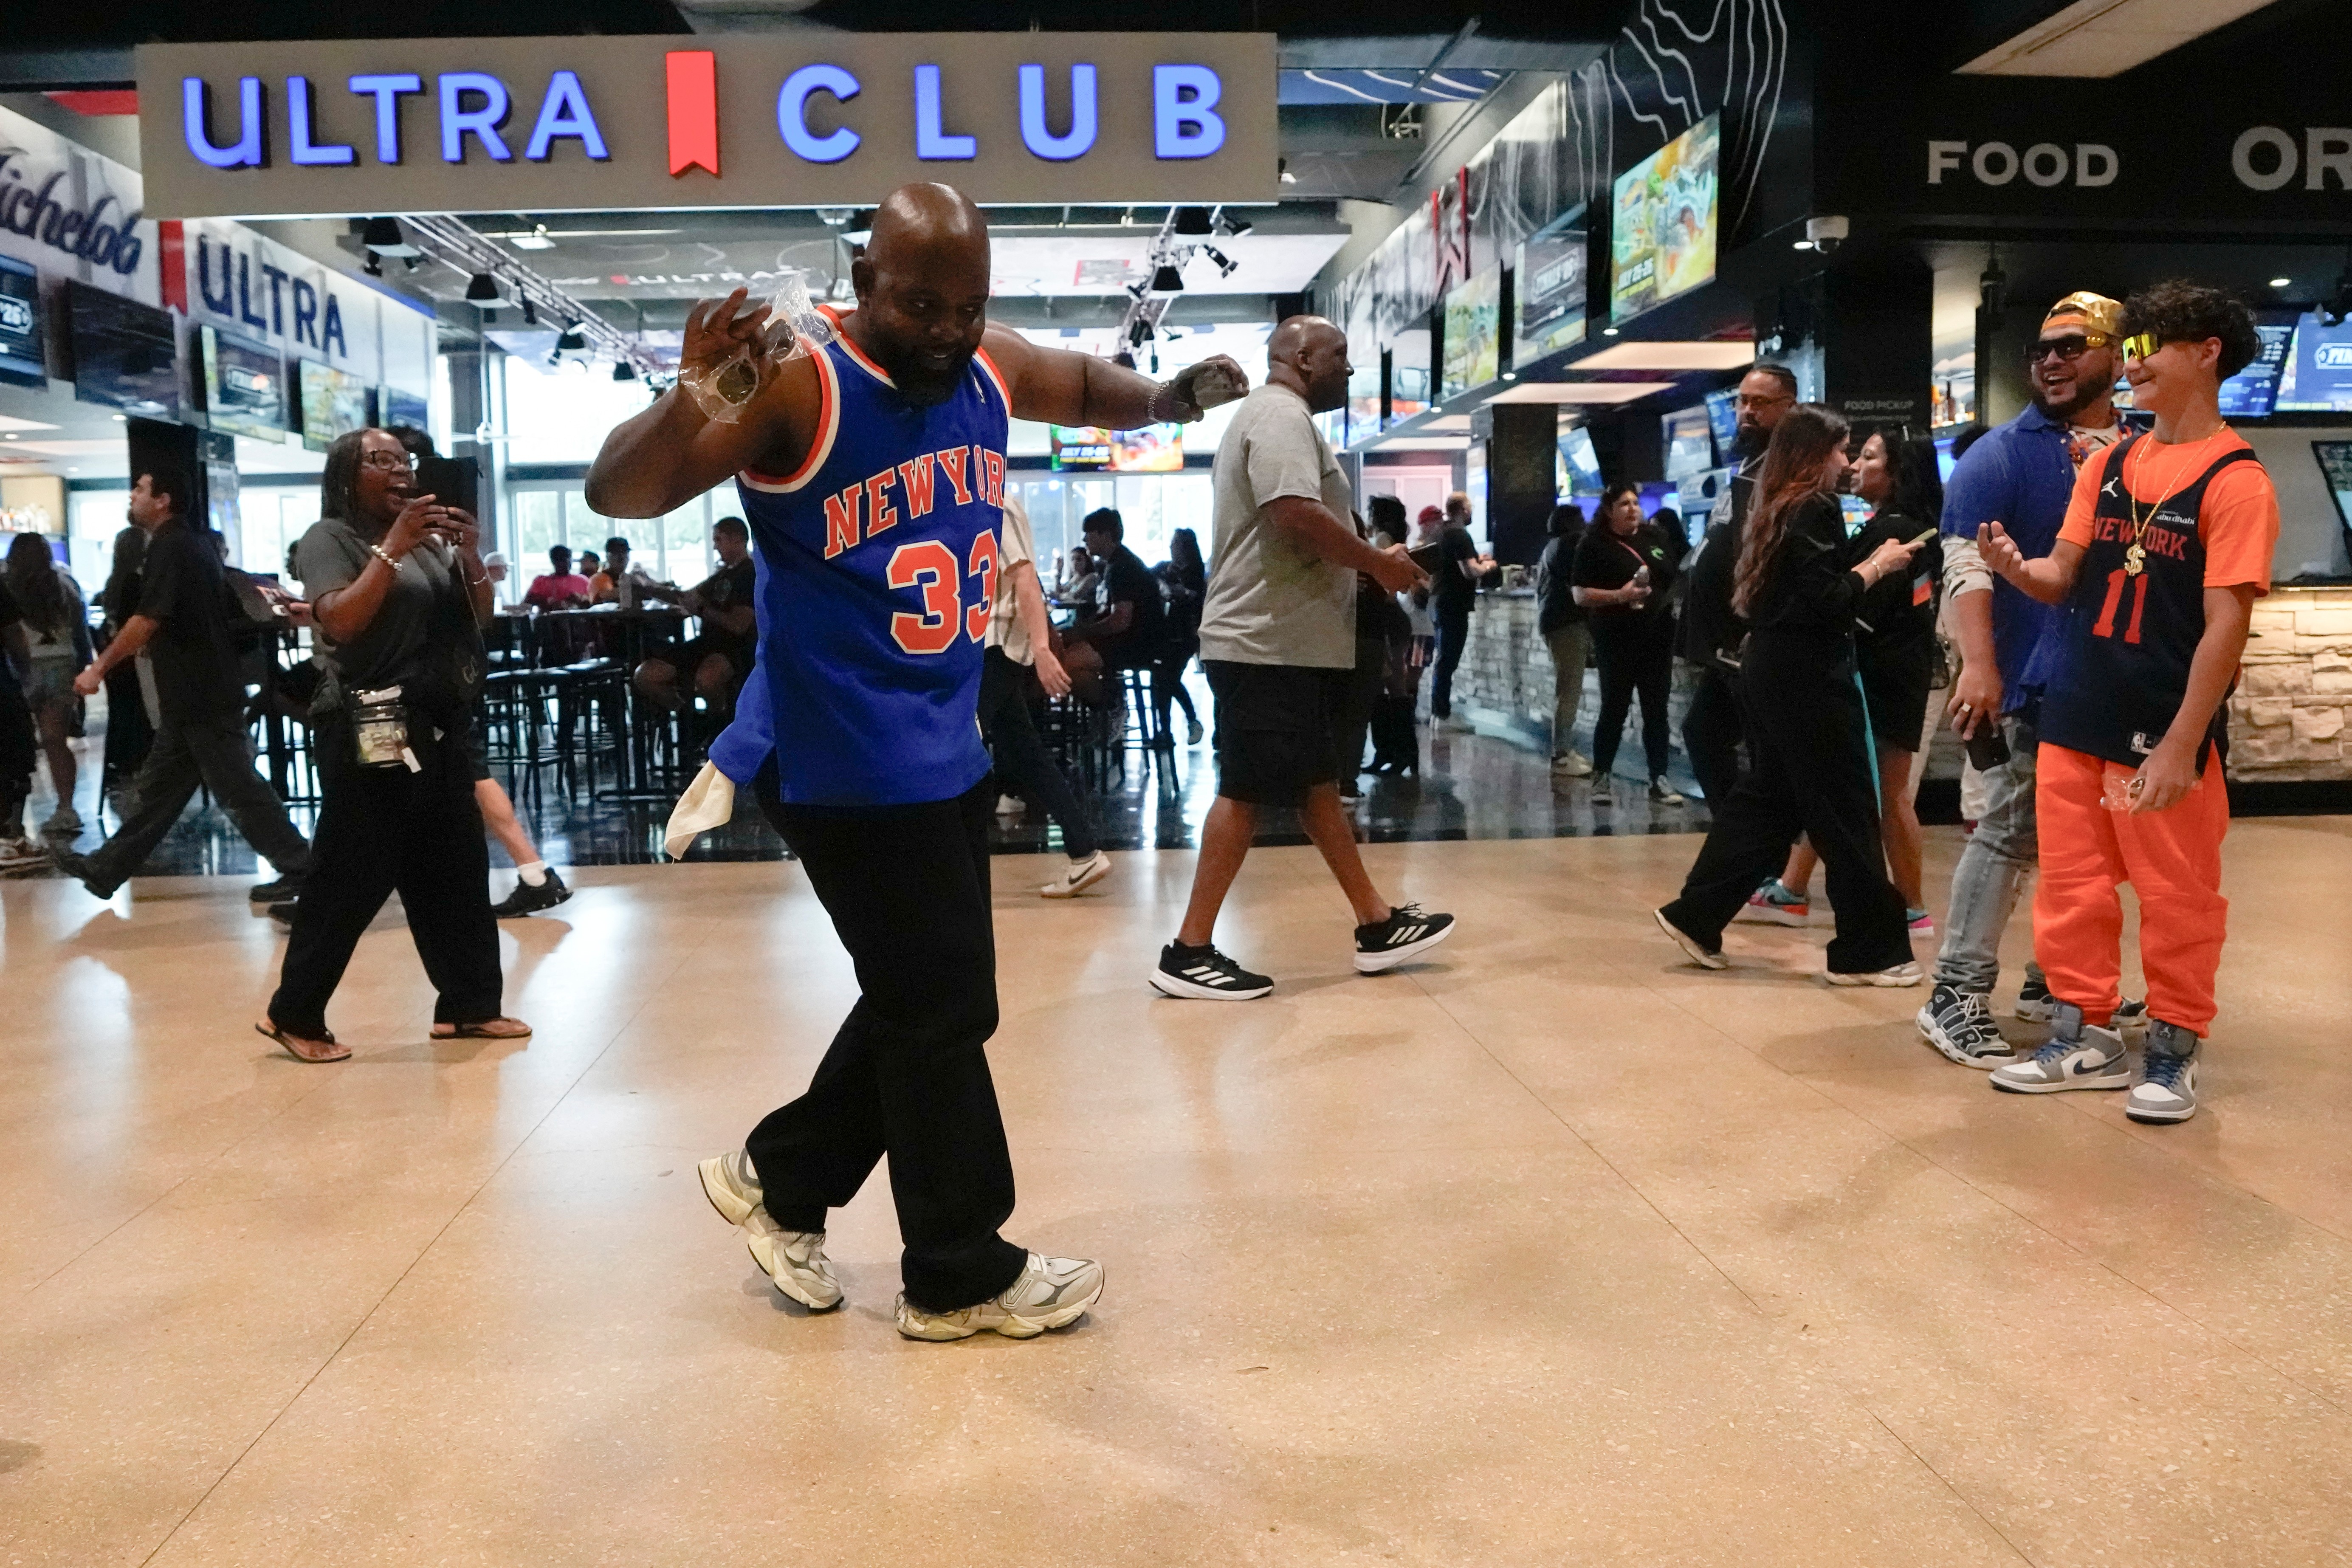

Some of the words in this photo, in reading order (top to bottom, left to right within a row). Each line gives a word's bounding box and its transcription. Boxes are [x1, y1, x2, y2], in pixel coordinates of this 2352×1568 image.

[183, 71, 609, 167] ULTRA
[778, 63, 1226, 161] CLUB
[1927, 140, 2119, 186] FOOD
[0, 154, 142, 274] ichelob
[198, 232, 347, 358] ULTRA
[1844, 400, 1874, 409] FOOD
[824, 453, 935, 560] NEW
[937, 444, 1007, 510] YOR
[886, 528, 998, 654] 33
[2093, 569, 2148, 644] 11
